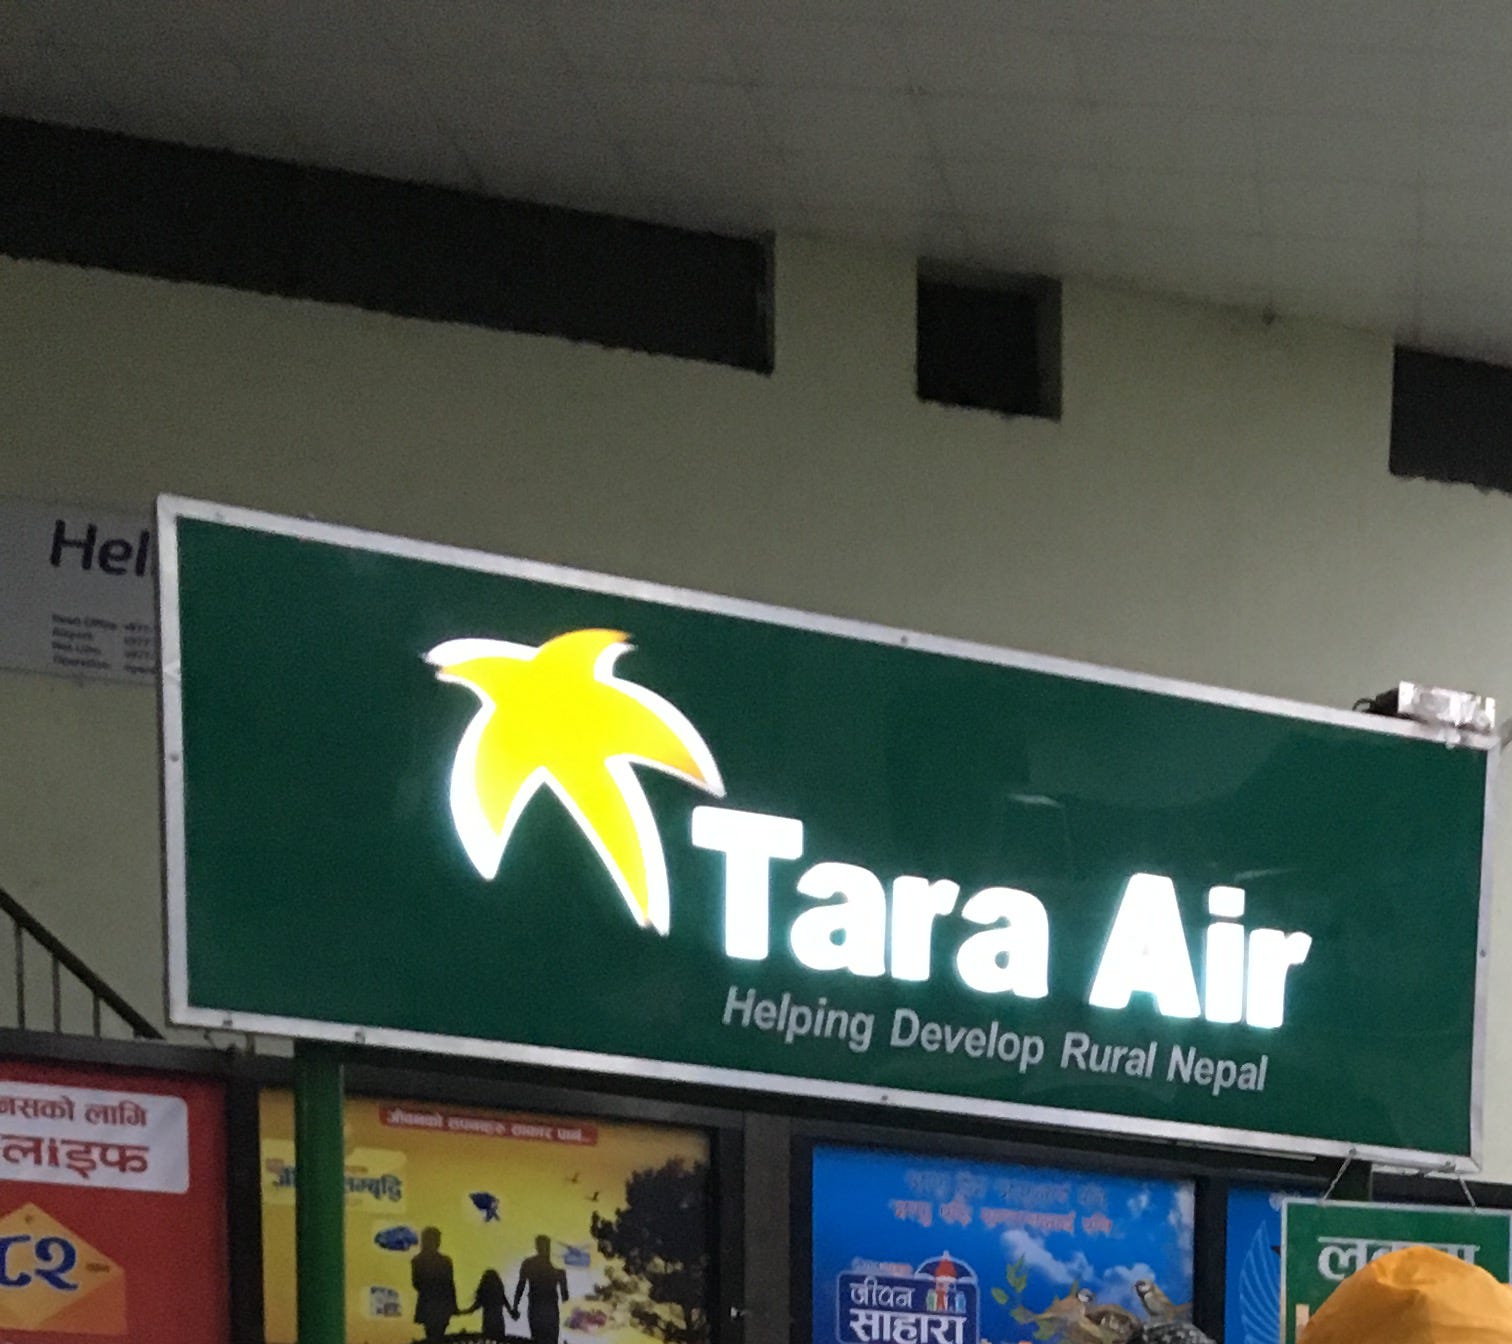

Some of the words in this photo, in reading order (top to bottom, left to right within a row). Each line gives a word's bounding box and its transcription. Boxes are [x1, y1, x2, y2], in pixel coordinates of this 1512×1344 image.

[51, 519, 153, 577] Hel
[691, 806, 1050, 999] Tara
[1089, 873, 1312, 1029] Air
[722, 985, 875, 1053] Helping
[890, 1008, 1045, 1073] Develop
[1061, 1031, 1158, 1078] Rural
[1167, 1045, 1269, 1097] Nepal
[84, 1099, 148, 1126] लागि
[849, 1276, 916, 1308] जीवन
